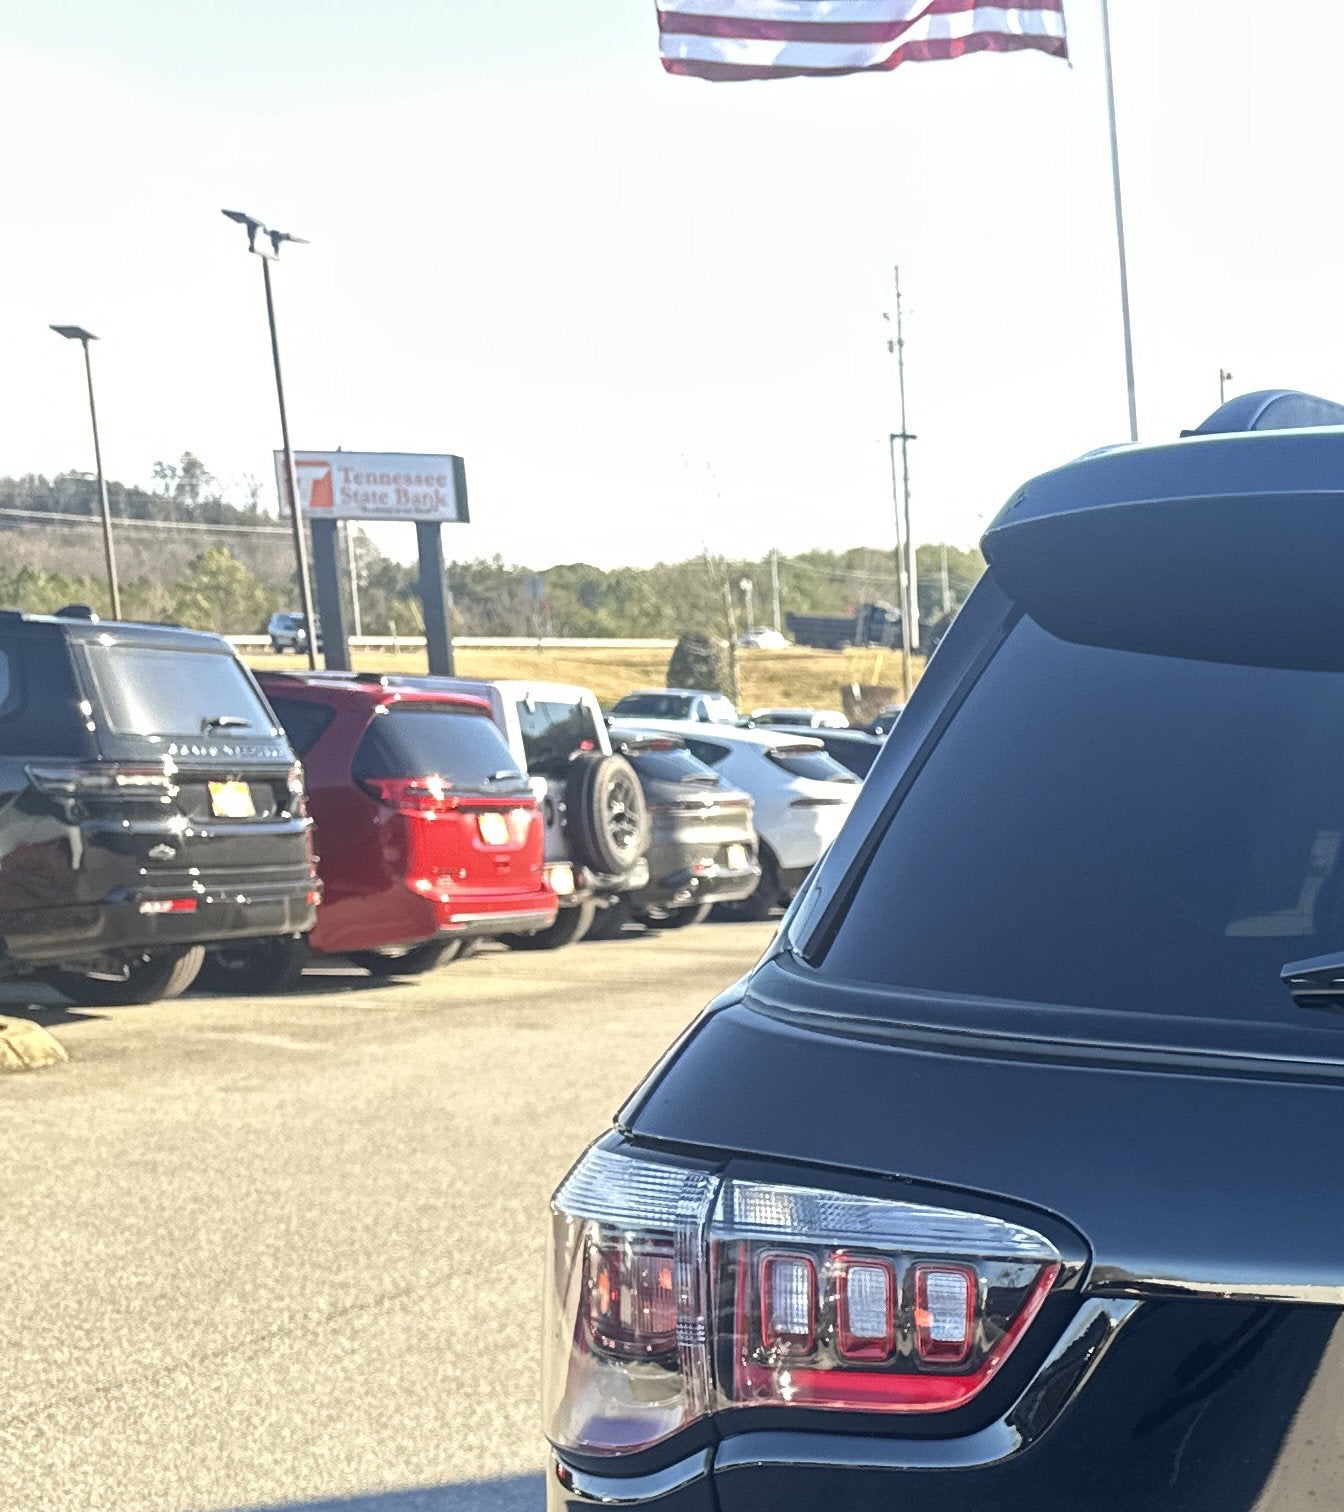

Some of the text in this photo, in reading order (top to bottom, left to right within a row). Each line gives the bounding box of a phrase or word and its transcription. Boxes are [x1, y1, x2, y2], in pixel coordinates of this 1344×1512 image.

[337, 465, 448, 487] Tennessee
[339, 486, 448, 507] State Bank
